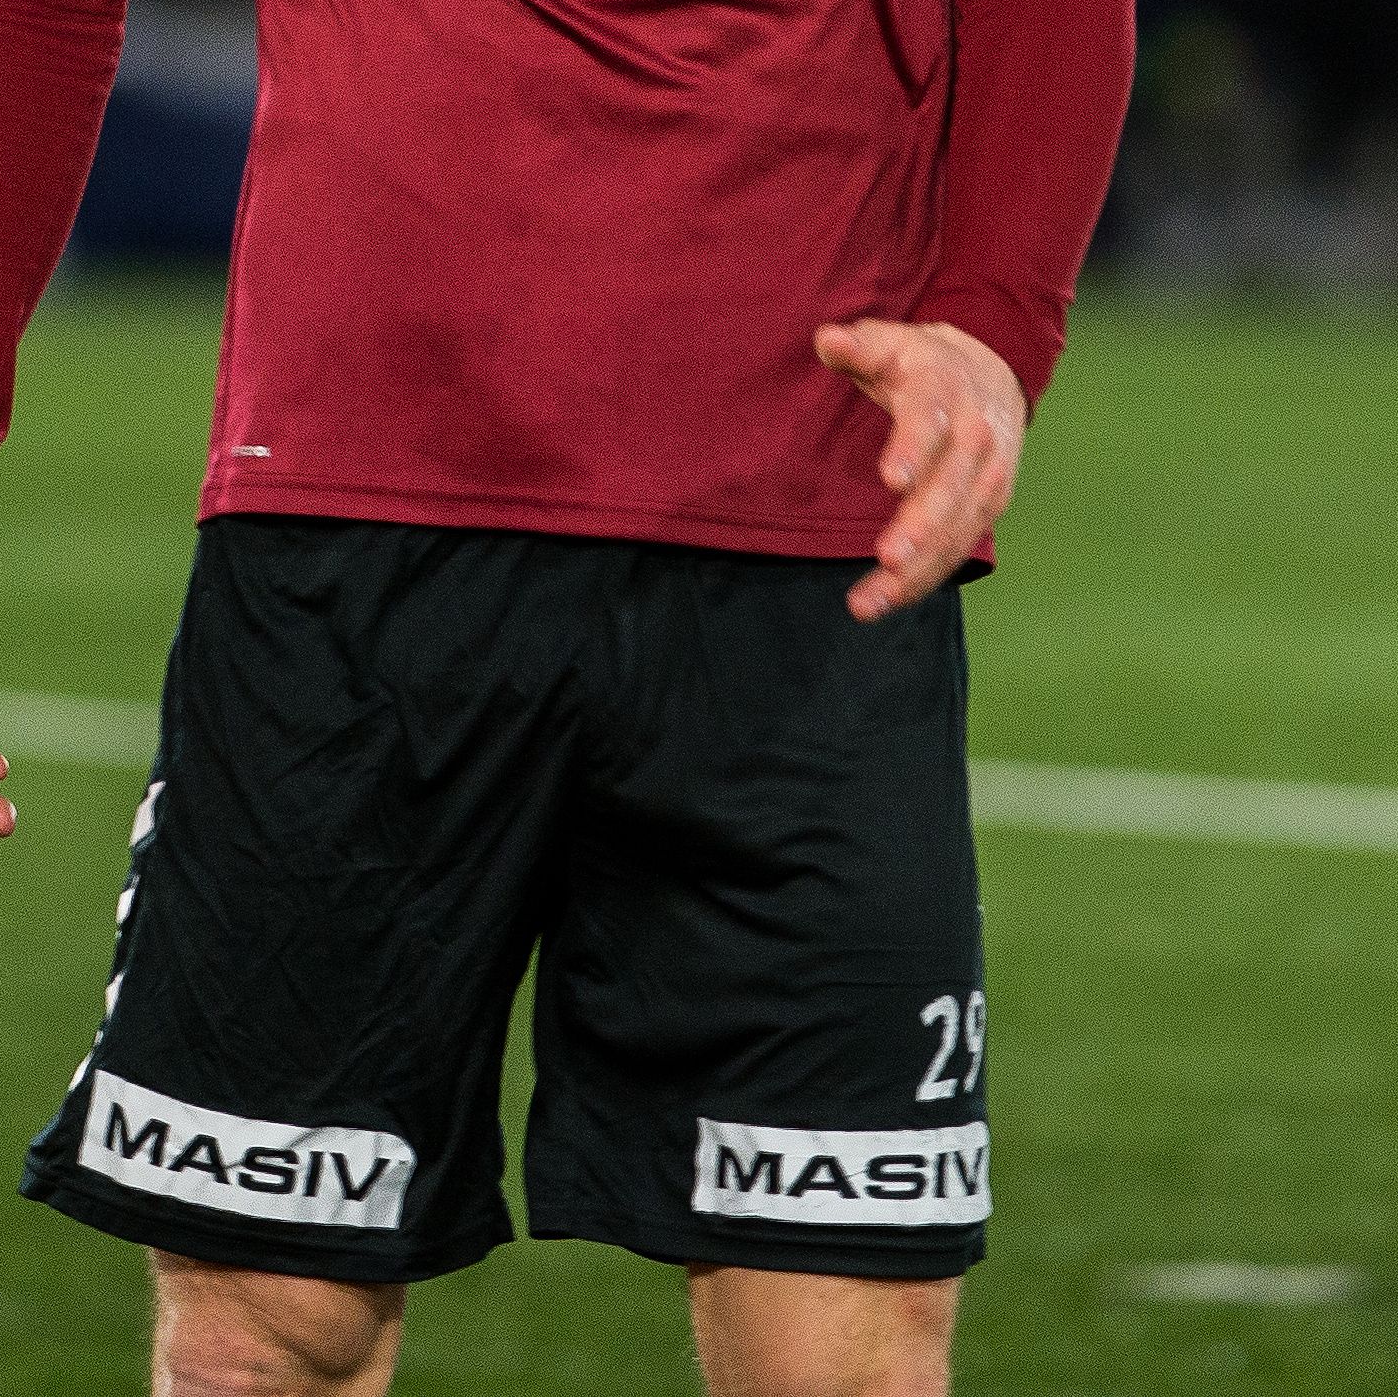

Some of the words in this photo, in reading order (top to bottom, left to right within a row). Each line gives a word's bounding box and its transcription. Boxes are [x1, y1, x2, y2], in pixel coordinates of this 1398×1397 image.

[915, 990, 987, 1102] 29
[104, 1101, 391, 1202] MASIV
[716, 1144, 989, 1200] MASIV
